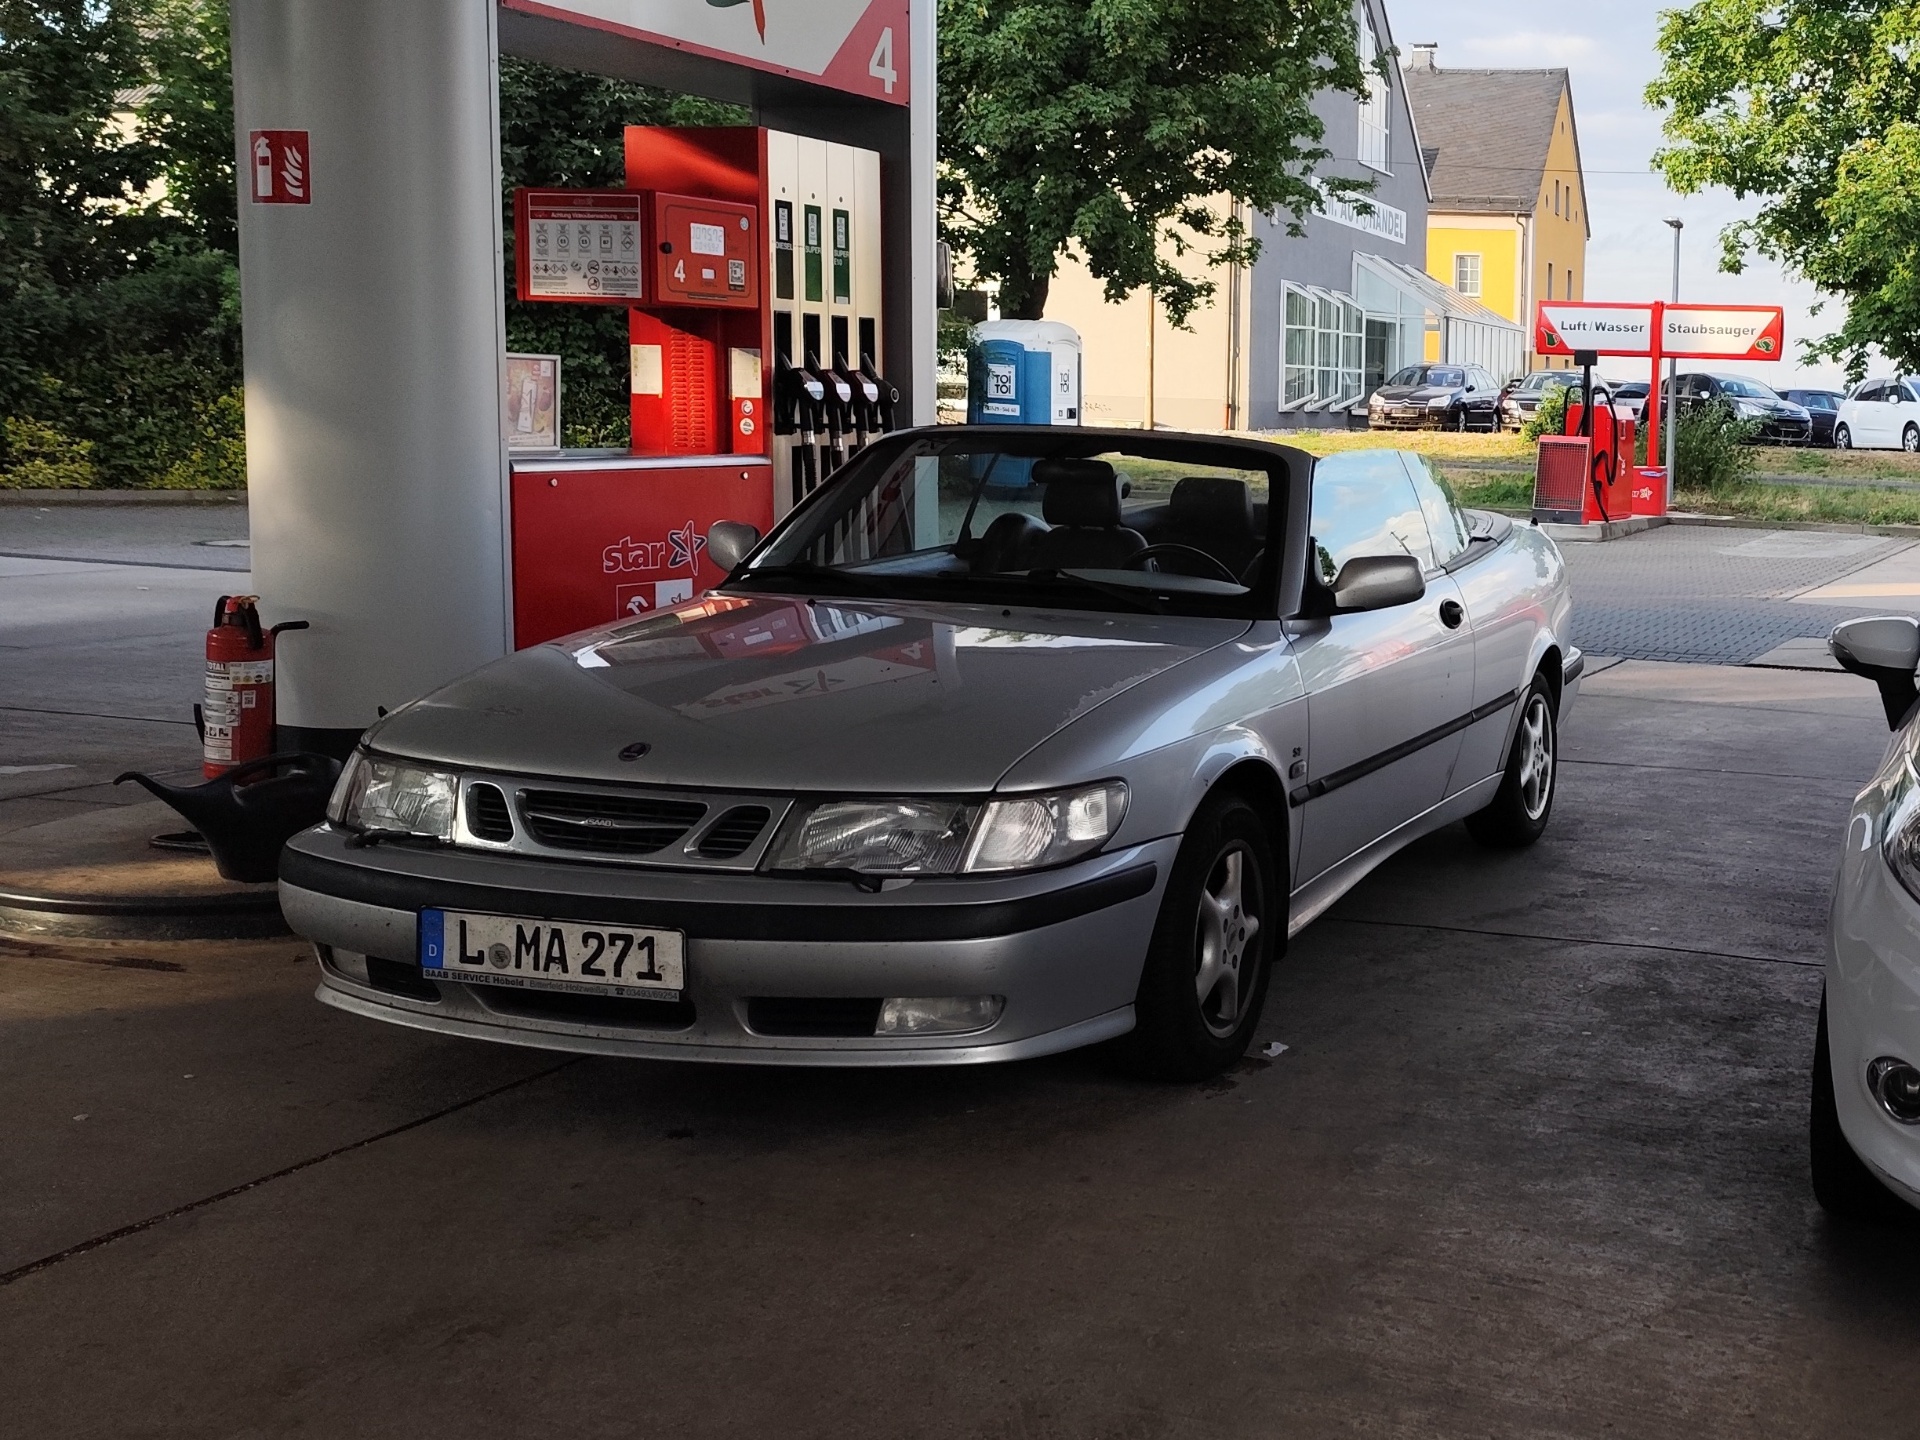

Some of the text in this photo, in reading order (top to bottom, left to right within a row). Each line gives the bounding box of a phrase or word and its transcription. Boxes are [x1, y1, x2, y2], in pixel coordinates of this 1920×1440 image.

[868, 26, 897, 94] 4
[551, 212, 618, 220] Achtung Videoüberwachung
[775, 241, 793, 251] DIESEL
[805, 245, 821, 255] SUPER
[833, 249, 849, 258] SUPER
[833, 257, 843, 266] E10
[674, 259, 686, 283] 4
[1668, 322, 1757, 337] Staubsauger
[602, 535, 666, 574] star
[207, 661, 225, 671] TOTAL
[588, 818, 612, 827] SAAB
[428, 943, 437, 957] D
[459, 919, 663, 982] L MA 271
[424, 969, 678, 1000] SAAB SERVICE Höbold Bitterfeld-Holzweißig 03493/69254
